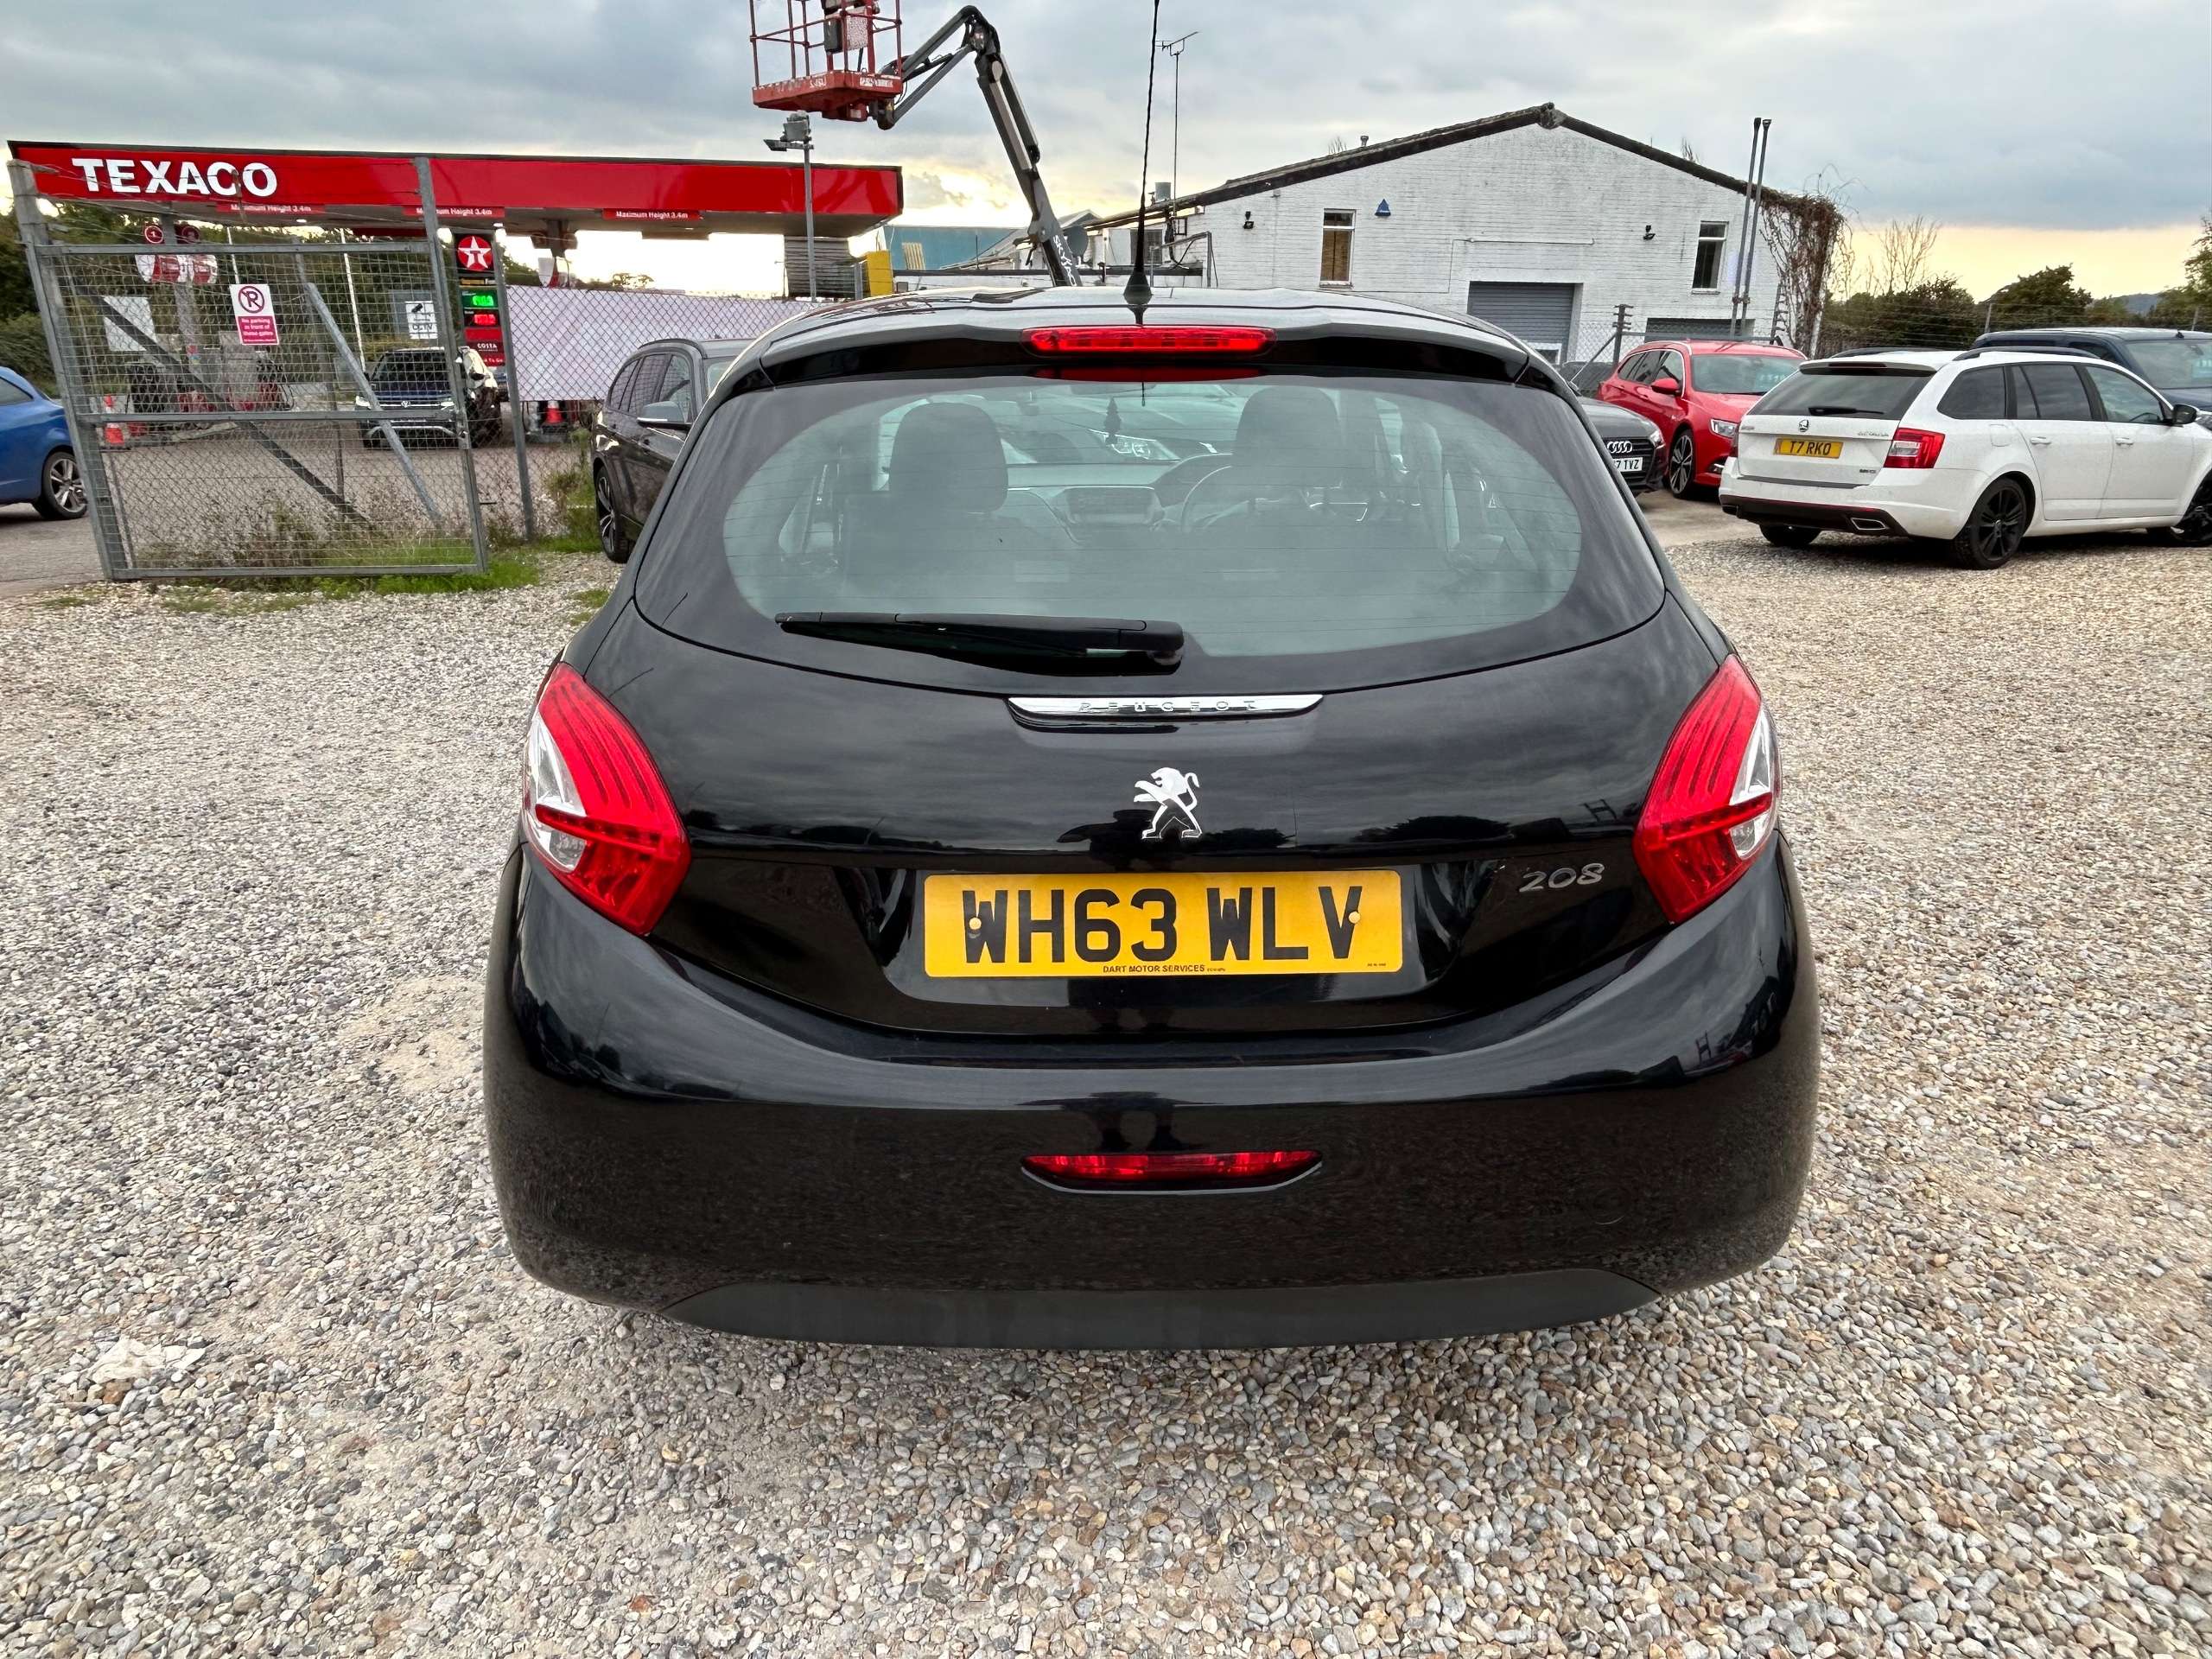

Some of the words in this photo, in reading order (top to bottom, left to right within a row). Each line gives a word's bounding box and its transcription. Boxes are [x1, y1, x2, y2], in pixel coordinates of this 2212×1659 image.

[72, 158, 277, 197] TEXACO
[1790, 441, 1805, 454] T7
[1080, 701, 1257, 713] PEUGEOT
[1519, 862, 1605, 893] 208
[963, 888, 1177, 963] WH63
[1206, 887, 1363, 961] WLV
